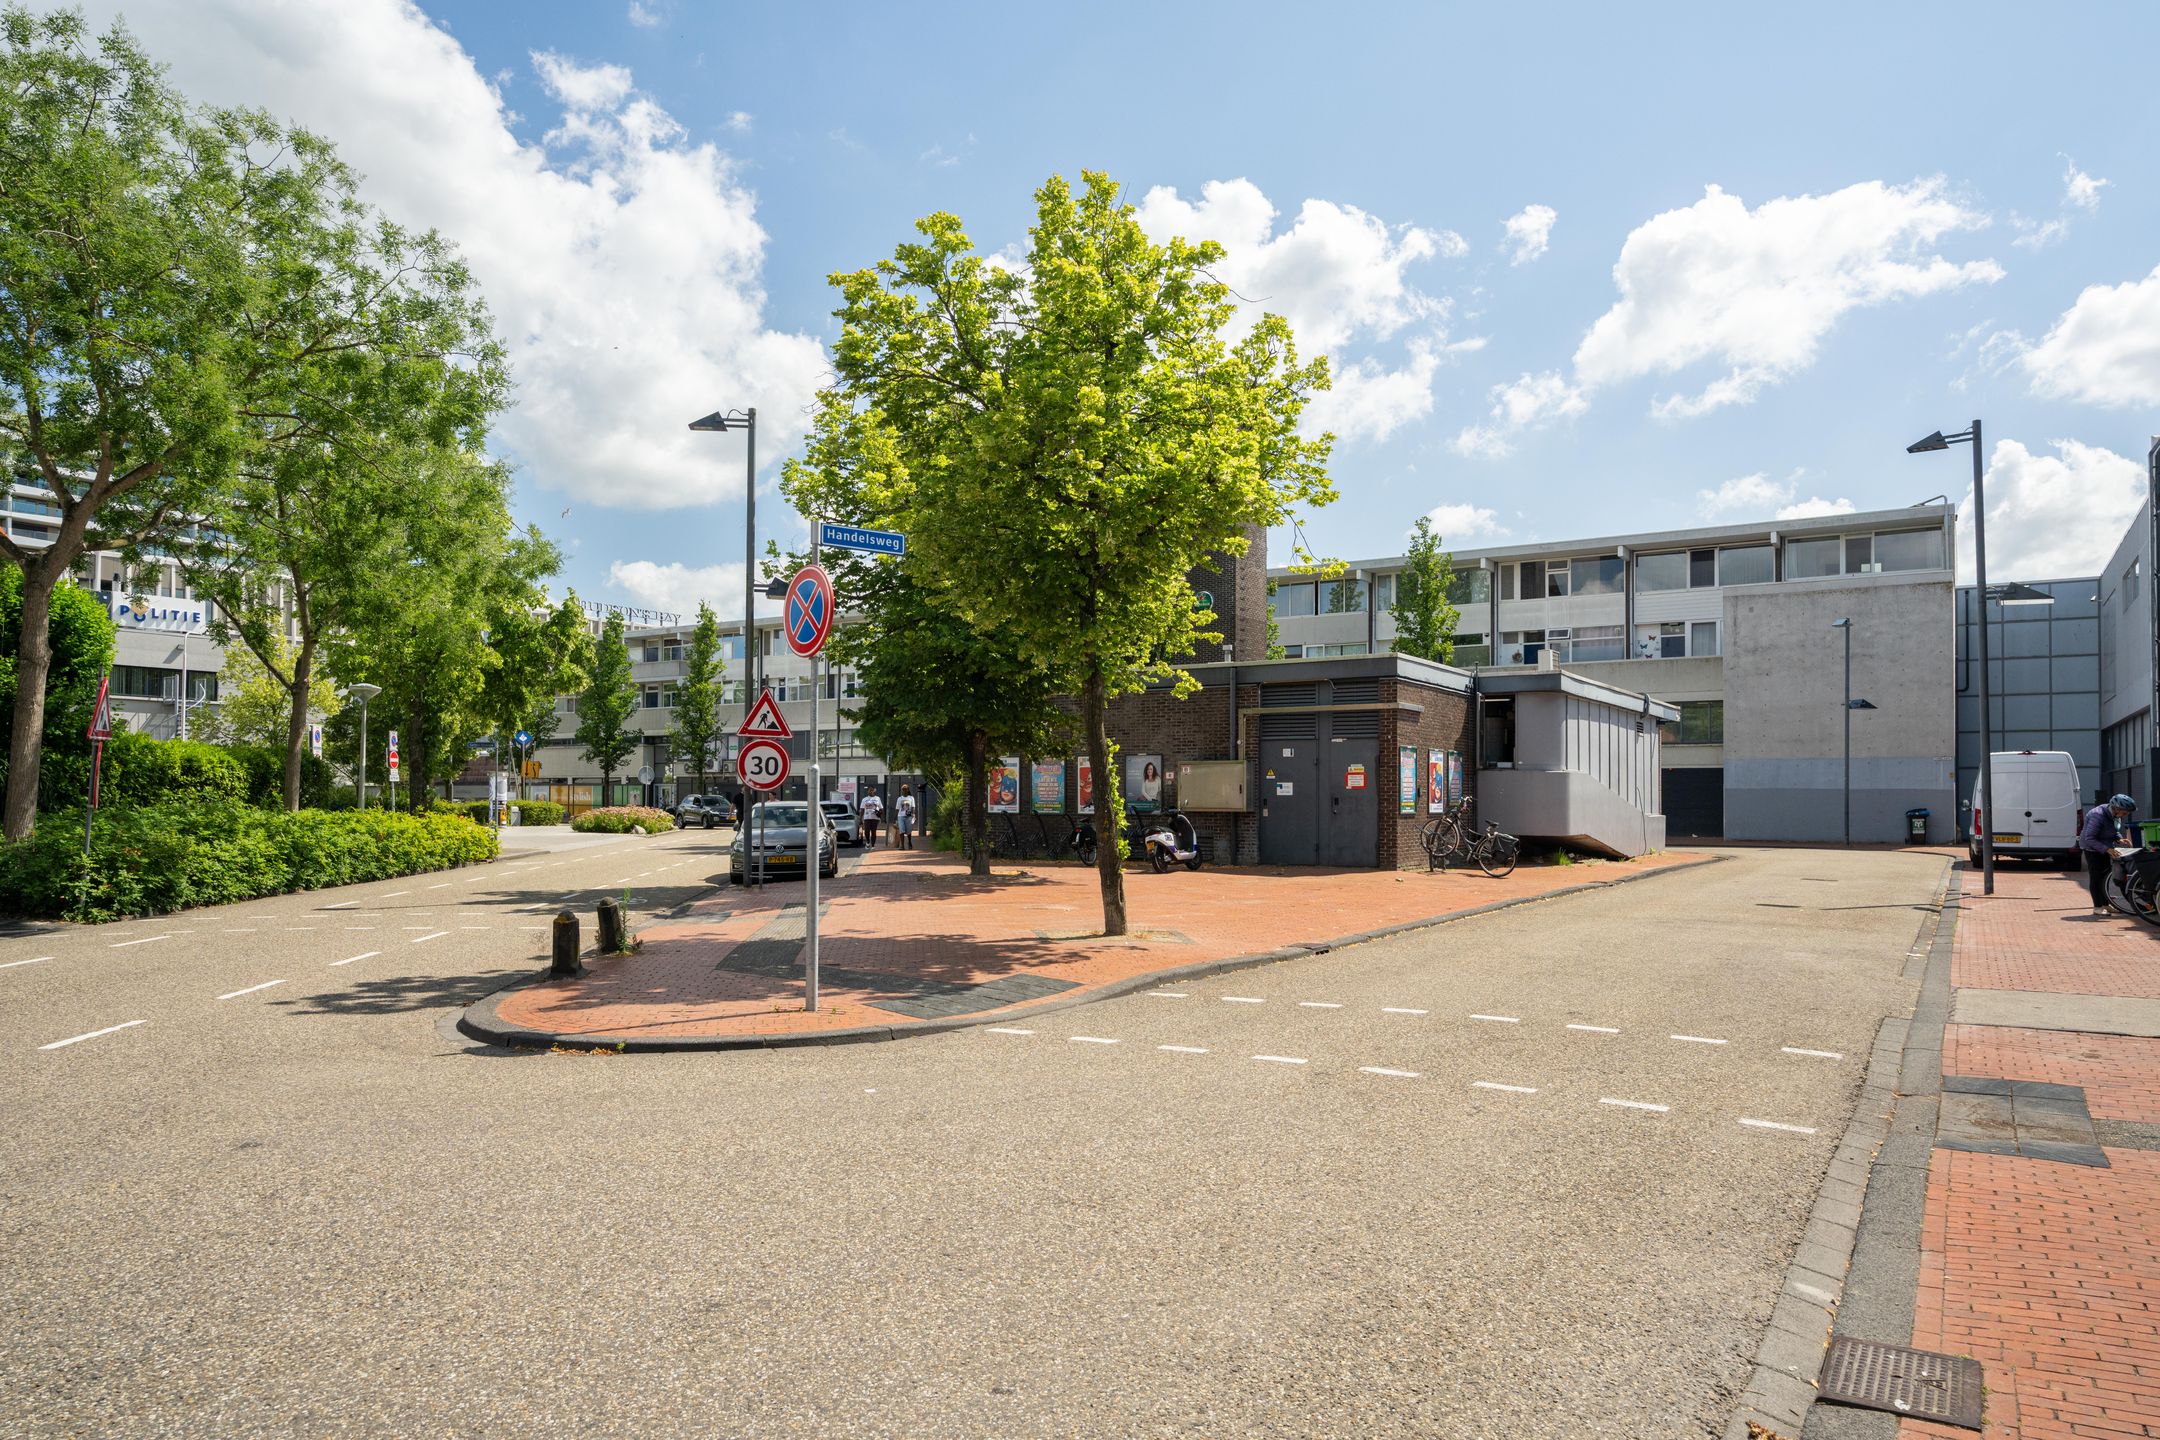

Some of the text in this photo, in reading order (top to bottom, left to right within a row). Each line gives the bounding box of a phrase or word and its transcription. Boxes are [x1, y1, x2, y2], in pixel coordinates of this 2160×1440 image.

[827, 528, 900, 551] Handelsweg
[119, 604, 201, 623] POLITIE
[750, 755, 780, 776] 30
